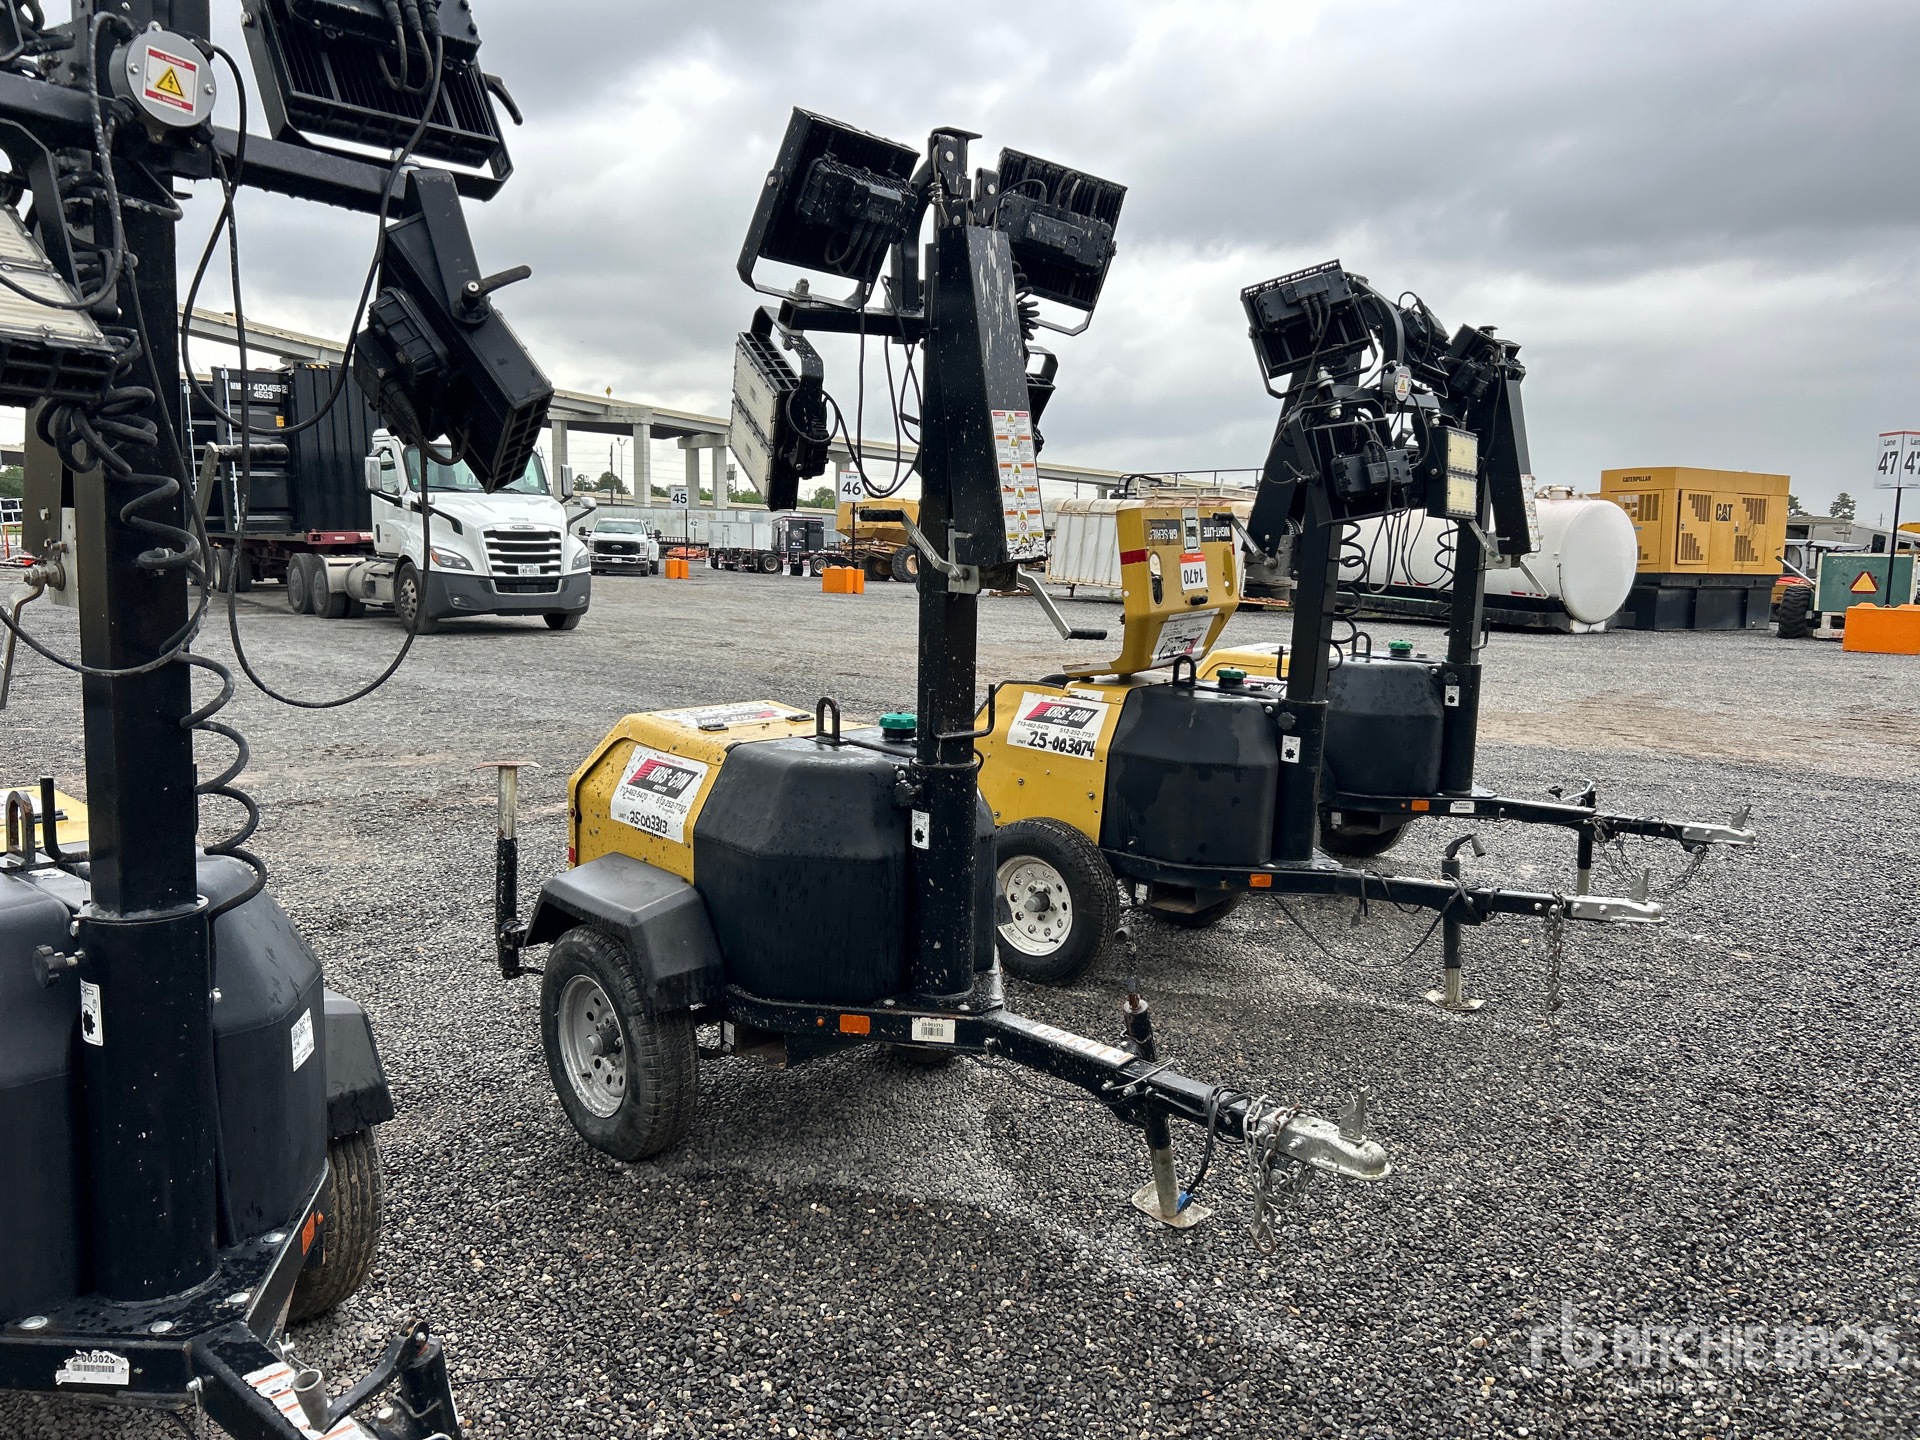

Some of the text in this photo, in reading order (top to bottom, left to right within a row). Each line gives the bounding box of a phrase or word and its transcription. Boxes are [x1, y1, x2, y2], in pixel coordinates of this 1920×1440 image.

[253, 383, 281, 393] 400455
[253, 391, 273, 399] 45G3
[1884, 439, 1896, 447] Lane
[1878, 450, 1899, 475] 47
[1622, 475, 1652, 483] CATERPILLAR
[842, 481, 862, 495] 46
[672, 493, 687, 504] 45
[1716, 503, 1733, 521] CAT
[1183, 568, 1204, 585] 1470
[1044, 705, 1093, 723] KRIS-CON
[1016, 721, 1050, 730] 713-462-5470
[1059, 727, 1095, 738] 512-252-7737
[1028, 730, 1096, 757] 25-003074
[646, 765, 694, 790] KRIS-CON
[619, 786, 649, 801] 713-462-5470
